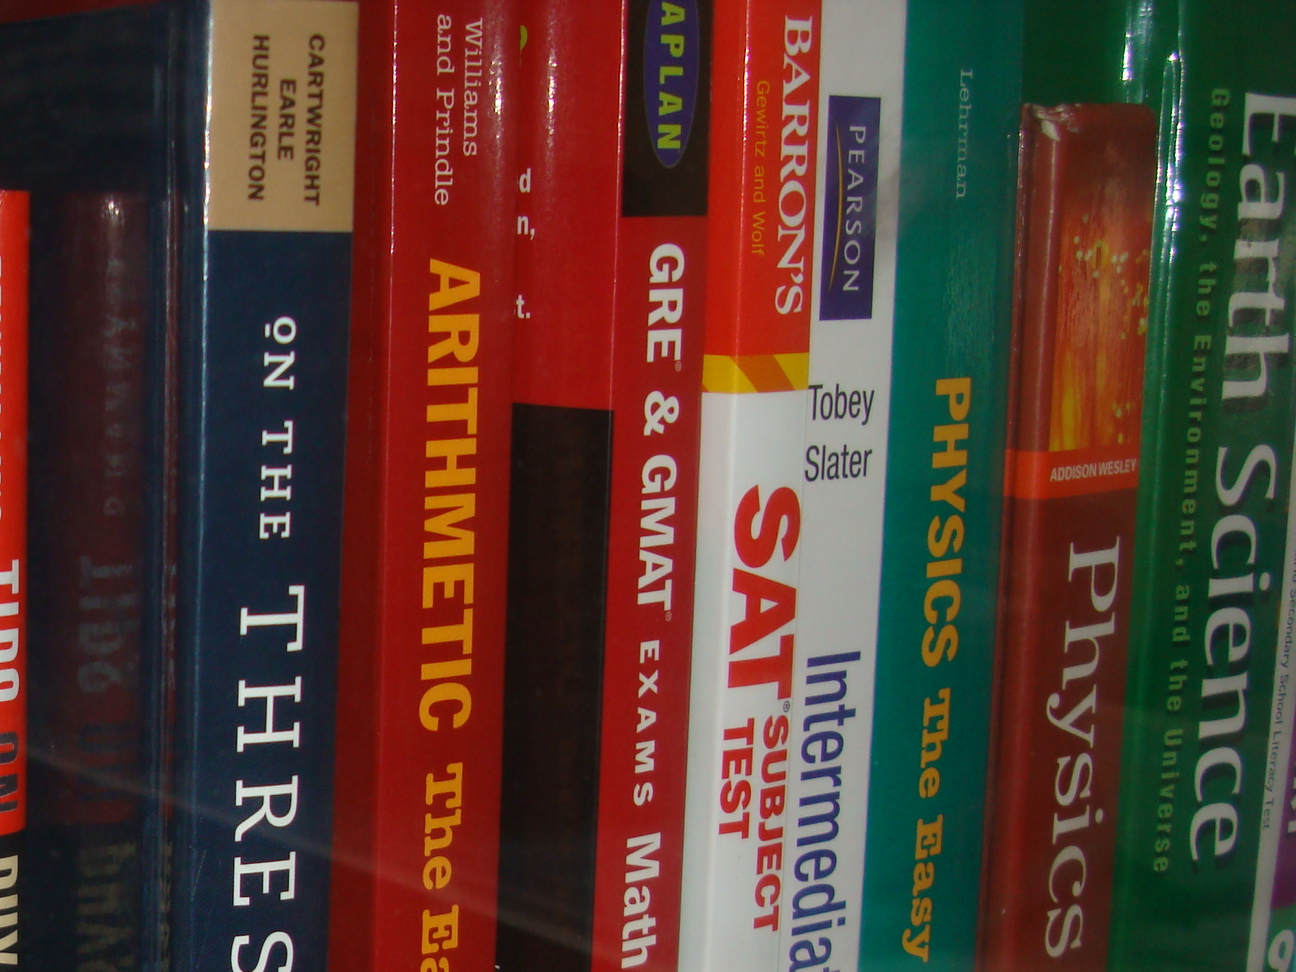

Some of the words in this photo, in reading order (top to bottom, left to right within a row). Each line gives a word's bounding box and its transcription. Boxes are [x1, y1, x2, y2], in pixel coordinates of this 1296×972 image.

[436, 14, 455, 76] and
[463, 17, 483, 156] Williams
[657, 1, 687, 151] APLAN
[247, 34, 270, 200] HURLINGTON
[277, 78, 297, 161] EARLE
[304, 33, 325, 206] CARTWRIGHT
[434, 87, 454, 206] Prindle
[755, 80, 771, 158] Gewirtz
[775, 15, 813, 315] BARRON'S
[956, 69, 973, 199] Lehrman
[751, 209, 766, 256] Wolf
[753, 165, 766, 204] and
[842, 125, 867, 292] PEARSON
[1221, 92, 1296, 401] Earth
[1196, 261, 1218, 317] the
[642, 390, 680, 437] &
[805, 444, 873, 482] Slater
[808, 384, 875, 426] Tobey
[259, 420, 294, 539] THE
[419, 258, 480, 731] ARITHMETIC
[921, 377, 971, 667] PHYSICS
[1050, 463, 1097, 482] ADDISON
[1098, 458, 1137, 476] WESLEY
[1172, 584, 1190, 642] and
[1189, 444, 1277, 863] Science
[632, 639, 660, 807] EXAMS
[919, 687, 951, 799] The
[1044, 535, 1120, 959] Physics
[1167, 660, 1188, 712] the
[1275, 674, 1289, 724] School
[718, 718, 755, 840] TEST
[753, 715, 789, 932] SUBJECT
[1153, 730, 1184, 874] Universe
[1266, 731, 1281, 793] Literacy
[423, 762, 463, 890] The
[902, 814, 944, 963] Easy
[621, 831, 661, 969] Math
